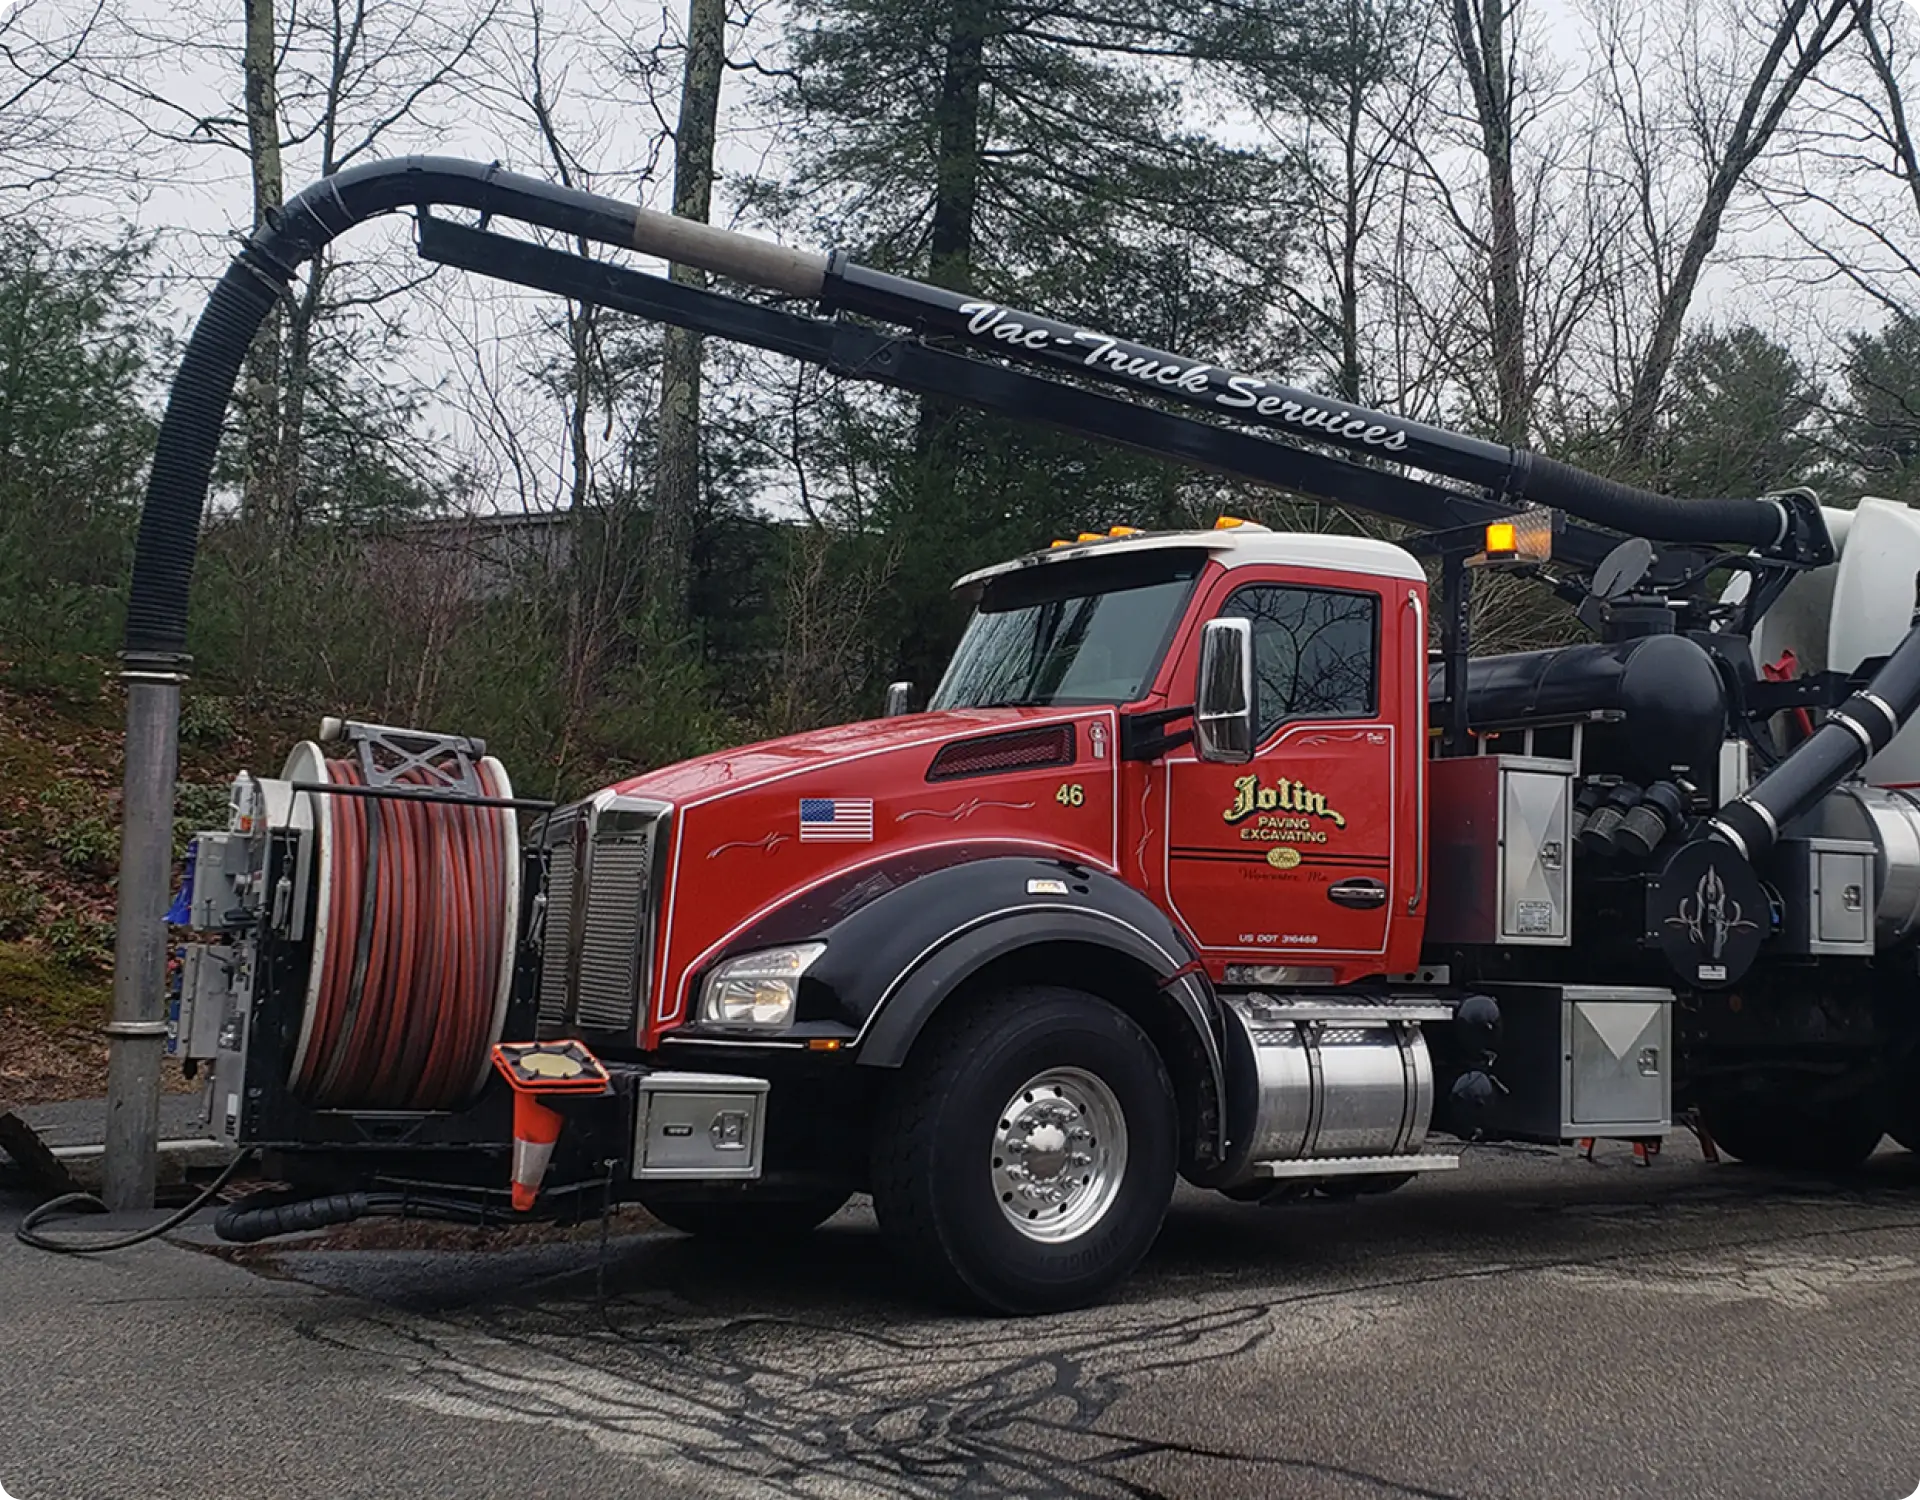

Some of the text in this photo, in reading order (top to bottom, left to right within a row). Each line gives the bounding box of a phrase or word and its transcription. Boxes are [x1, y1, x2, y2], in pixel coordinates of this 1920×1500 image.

[959, 302, 1408, 452] Vac-Truck Services
[1056, 783, 1084, 806] 46
[1222, 774, 1346, 829] Jolin
[1258, 816, 1310, 829] PAVING
[1240, 828, 1328, 844] EXCAVATING
[1238, 933, 1254, 943] US
[1256, 933, 1280, 943] DOT
